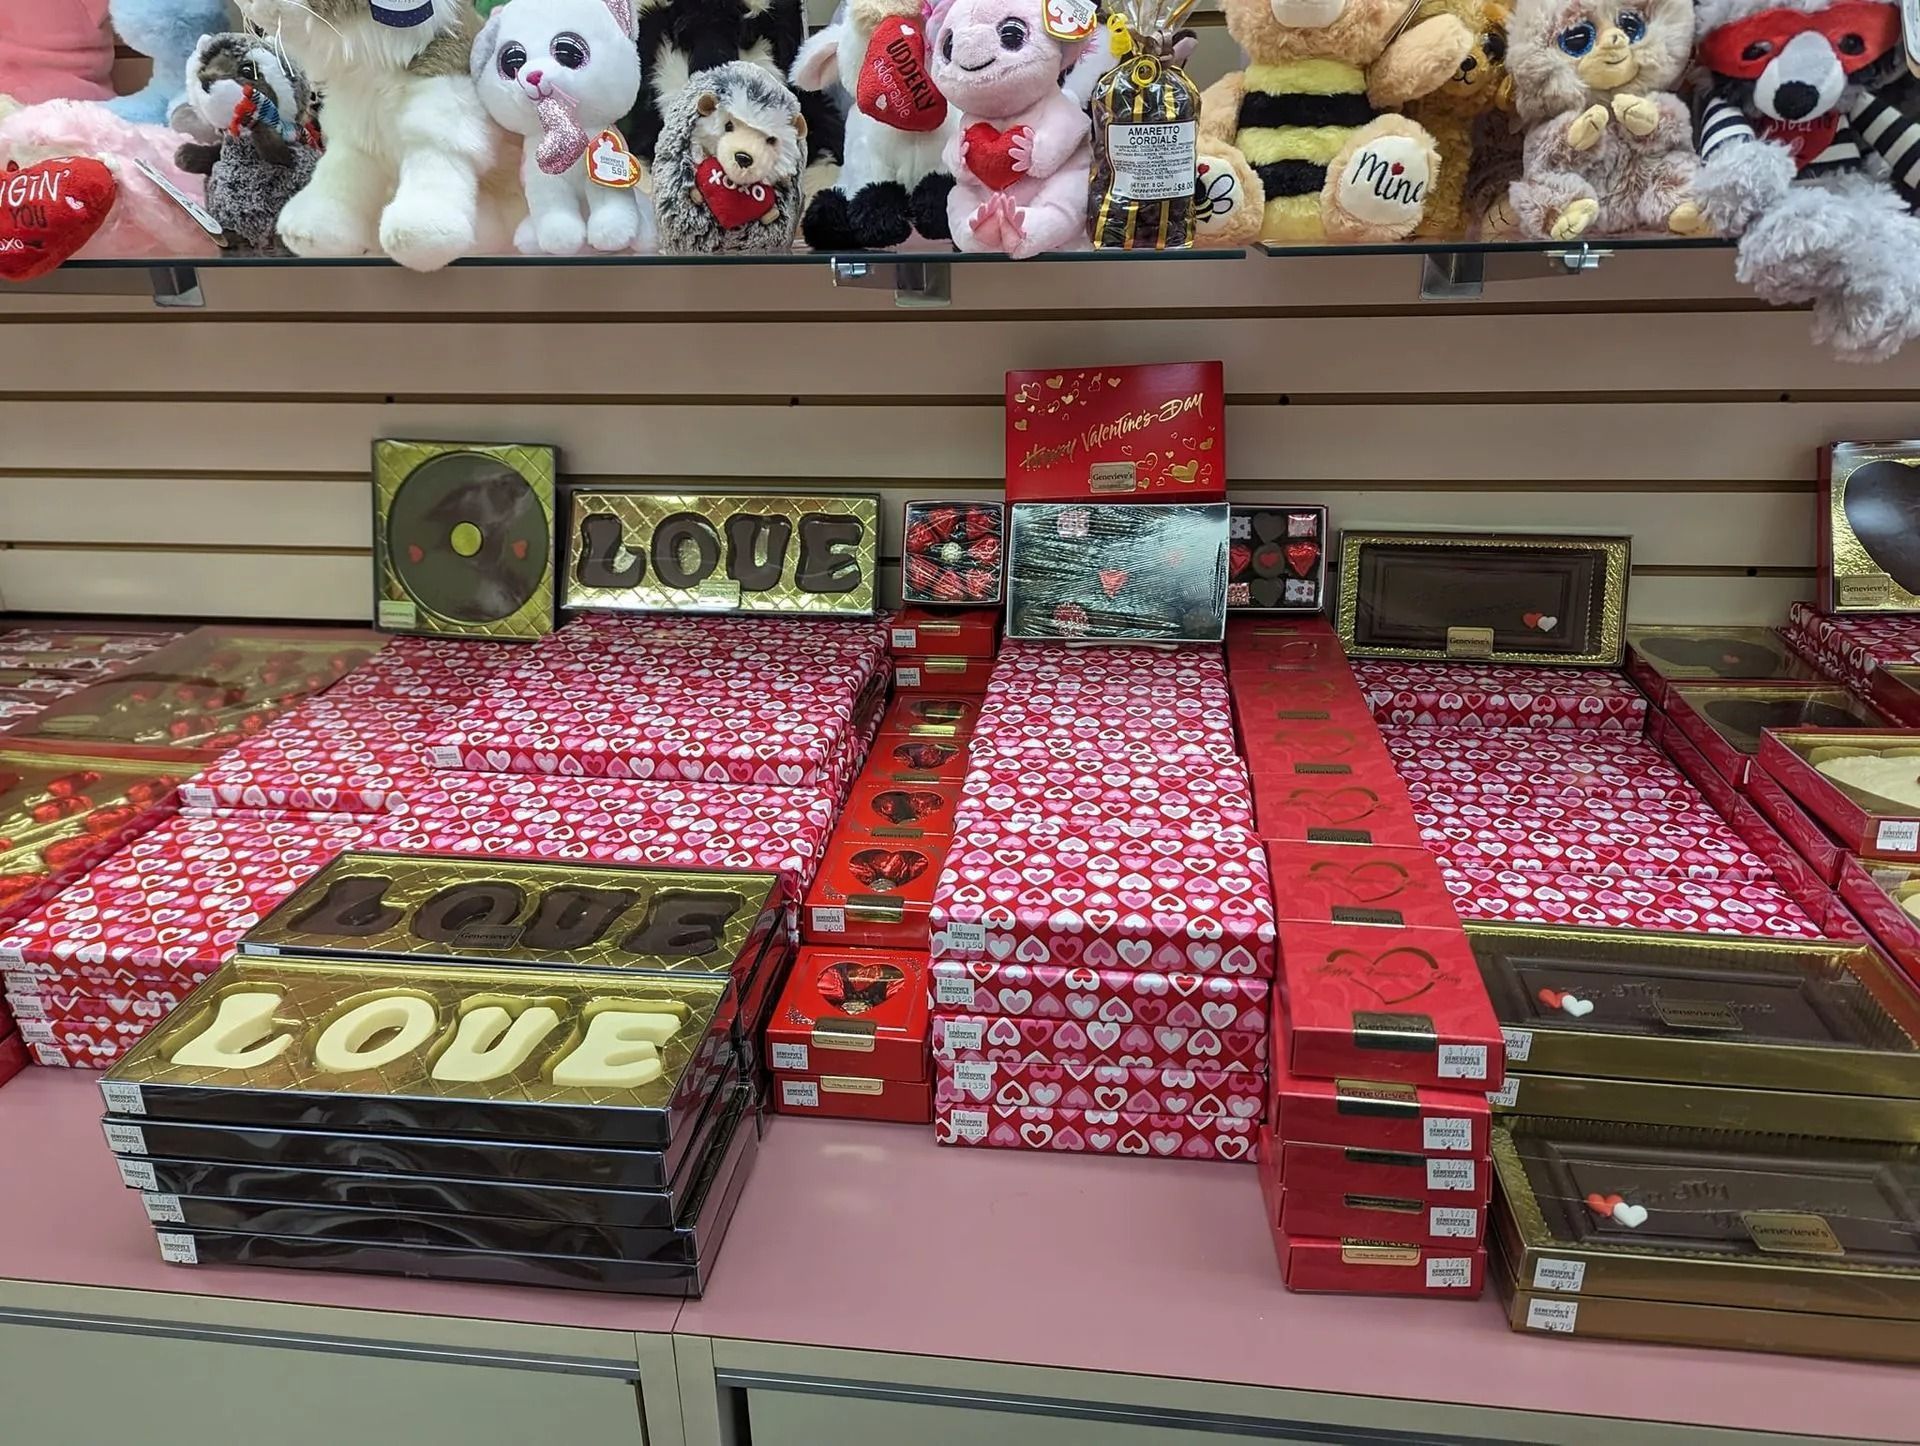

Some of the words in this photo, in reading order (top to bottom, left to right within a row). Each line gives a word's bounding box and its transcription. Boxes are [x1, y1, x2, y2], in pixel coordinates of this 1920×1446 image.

[873, 57, 912, 118] adorable
[886, 37, 936, 111] UDDERLY
[1128, 126, 1180, 136] AMARETTO
[1130, 135, 1178, 145] CORDIALS
[0, 168, 70, 207] GIN'
[1351, 152, 1424, 204] Mine
[10, 203, 47, 229] YOU
[1019, 438, 1077, 470] Happy
[1081, 409, 1155, 452] Valentine's
[1158, 393, 1203, 421] Day
[1092, 472, 1133, 480] Genevieve's
[577, 512, 864, 593] LOVE
[1843, 584, 1888, 592] Genevieve's
[1450, 637, 1489, 645] Genevieve's
[287, 874, 746, 955] LOVE
[170, 990, 682, 1087] LOVE
[1341, 1087, 1415, 1100] Genevieve's
[1752, 1224, 1830, 1238] Genevieve's
